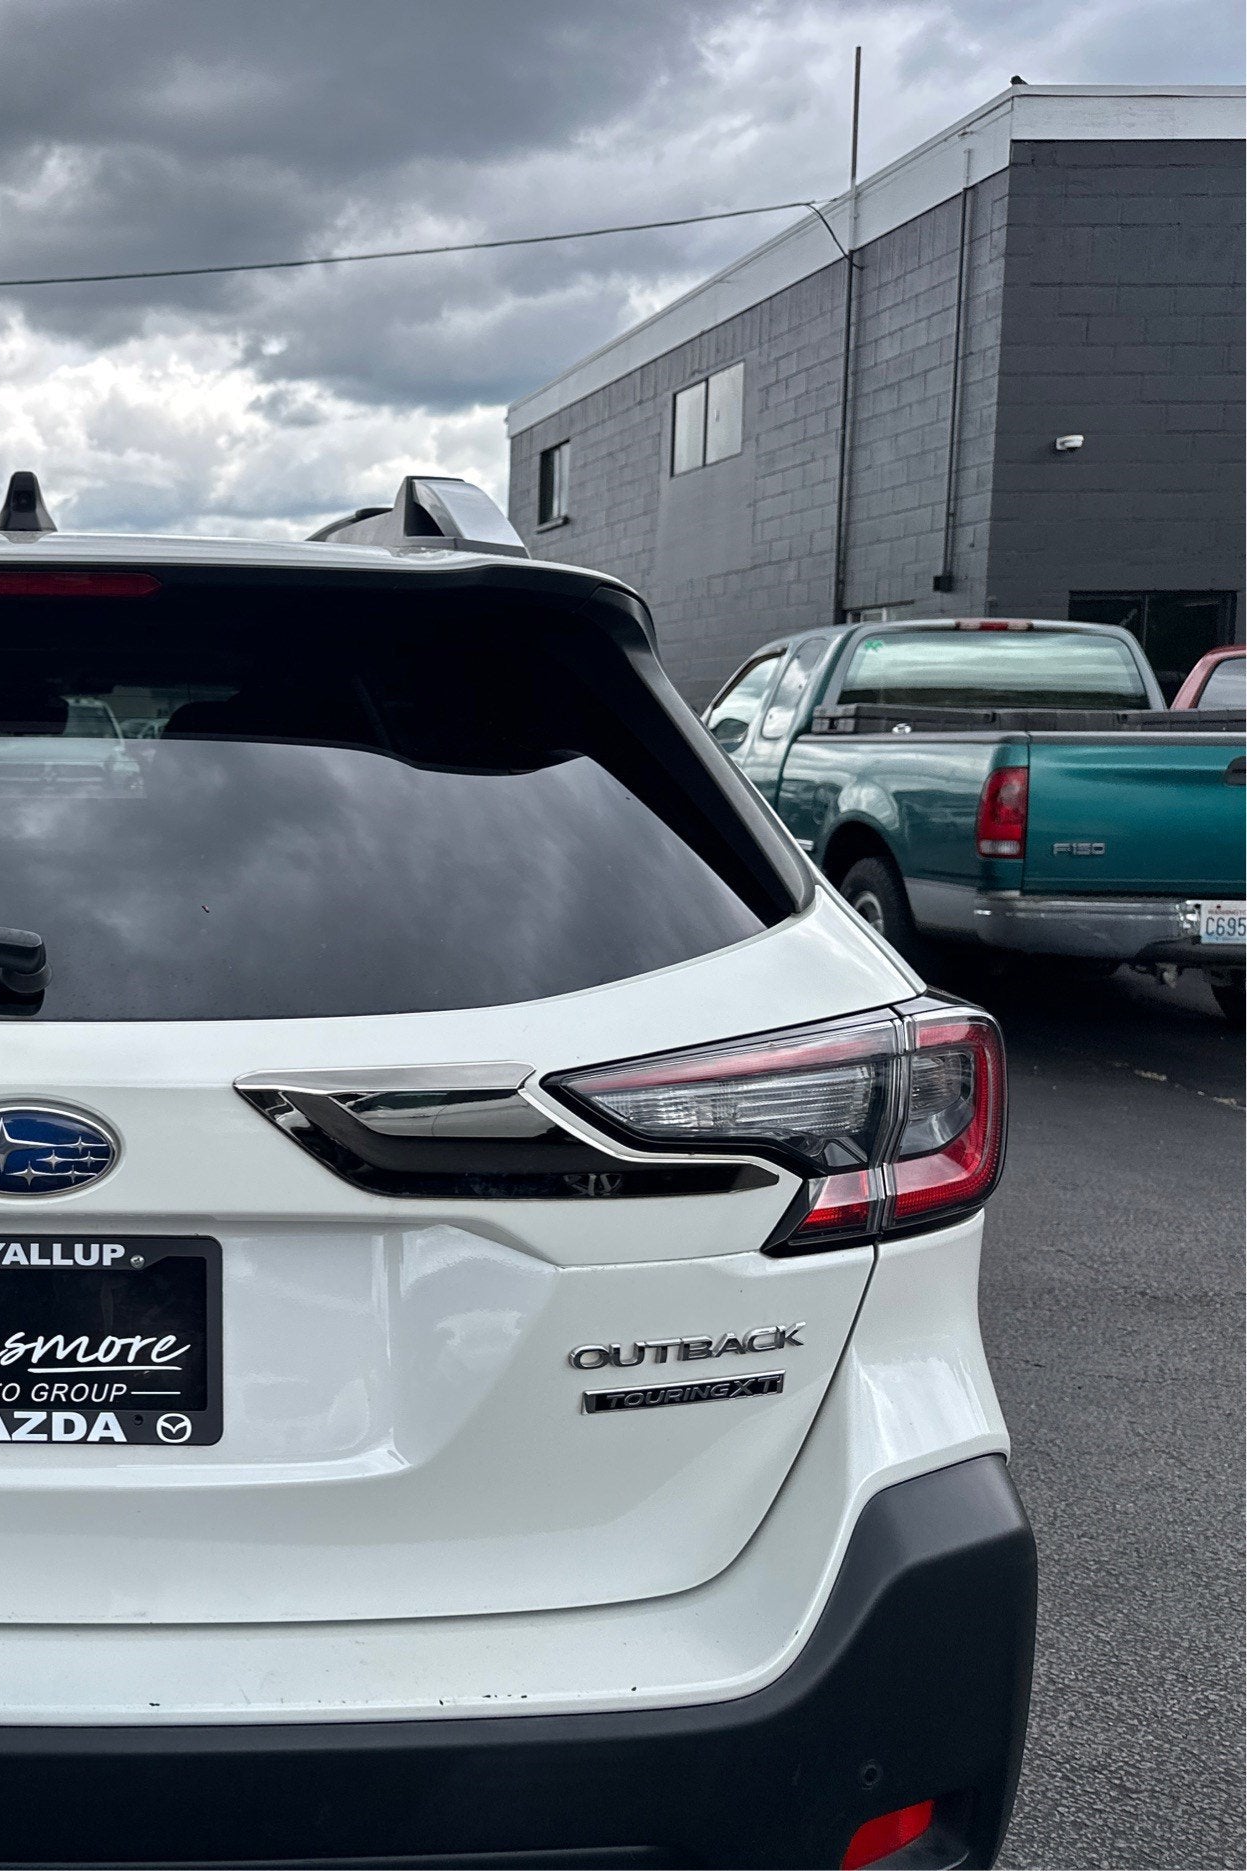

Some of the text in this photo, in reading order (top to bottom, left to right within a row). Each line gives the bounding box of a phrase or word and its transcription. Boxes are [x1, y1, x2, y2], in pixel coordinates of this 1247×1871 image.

[1053, 842, 1105, 855] F150
[568, 1320, 807, 1371] OUTBACK
[30, 1382, 128, 1402] GROUP
